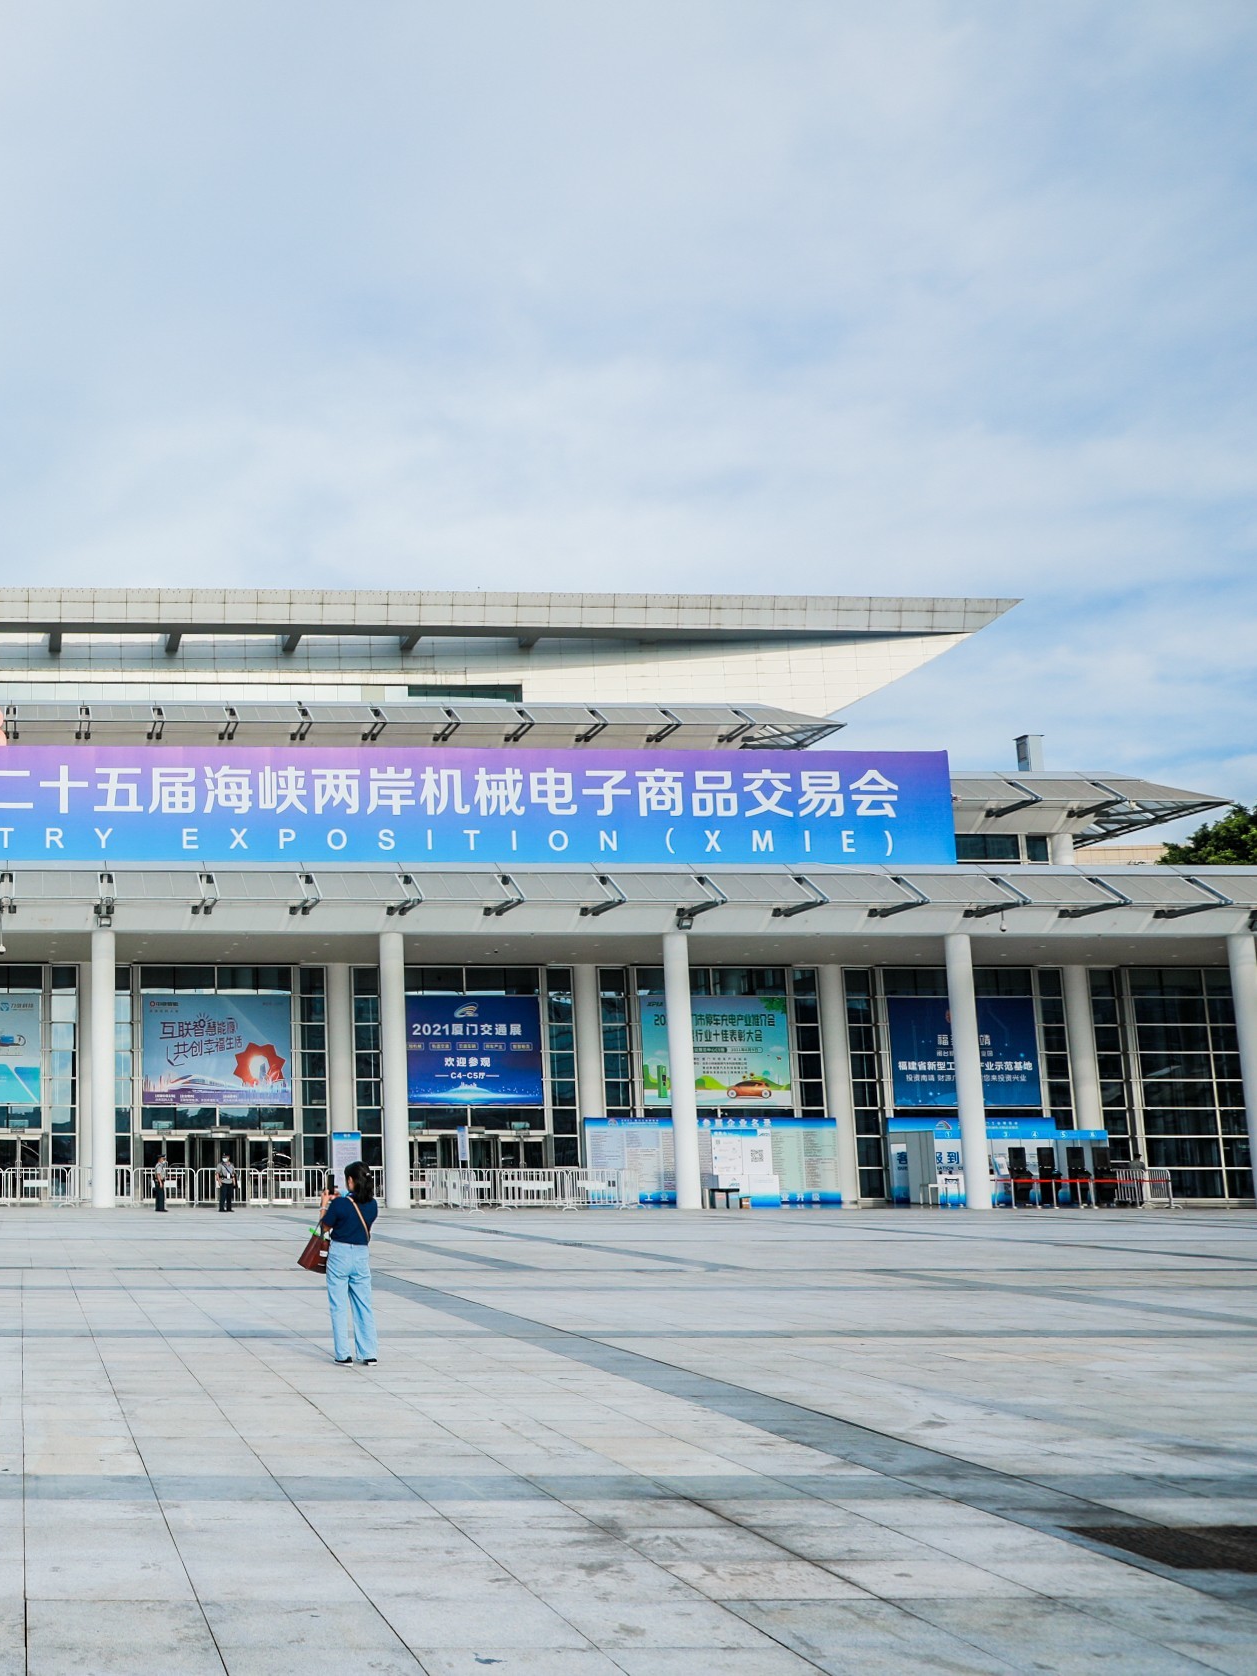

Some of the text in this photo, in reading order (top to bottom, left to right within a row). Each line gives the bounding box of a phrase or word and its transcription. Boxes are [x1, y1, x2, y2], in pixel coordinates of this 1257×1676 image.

[182, 827, 618, 853] EXPOSITION
[666, 828, 894, 858] (XMIE)
[412, 1023, 522, 1036] 2021厦门交通展
[693, 1029, 762, 1042] 行业十佳表彰大会
[173, 1035, 242, 1062] 共创幸福生活
[444, 1057, 491, 1067] 欢迎参观
[699, 1118, 772, 1128] 参展企业名录
